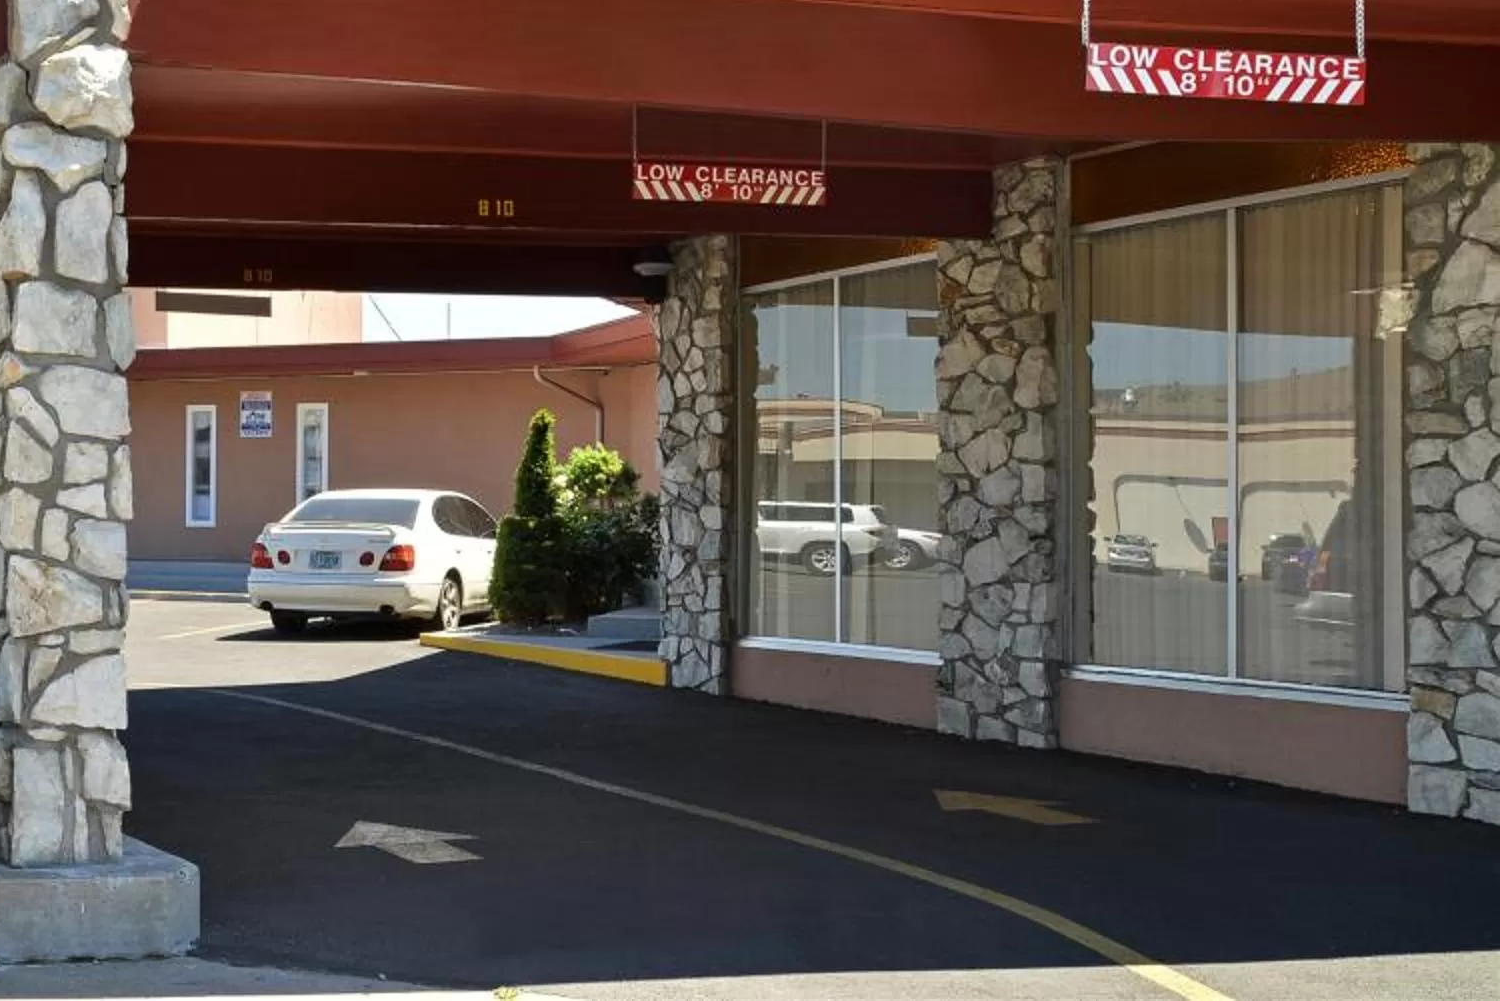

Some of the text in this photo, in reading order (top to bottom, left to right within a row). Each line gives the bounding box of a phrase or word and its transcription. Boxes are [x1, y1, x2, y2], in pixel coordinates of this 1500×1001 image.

[1090, 45, 1362, 79] LOW CLEARANCE
[637, 164, 825, 187] LOW CLEARANCE
